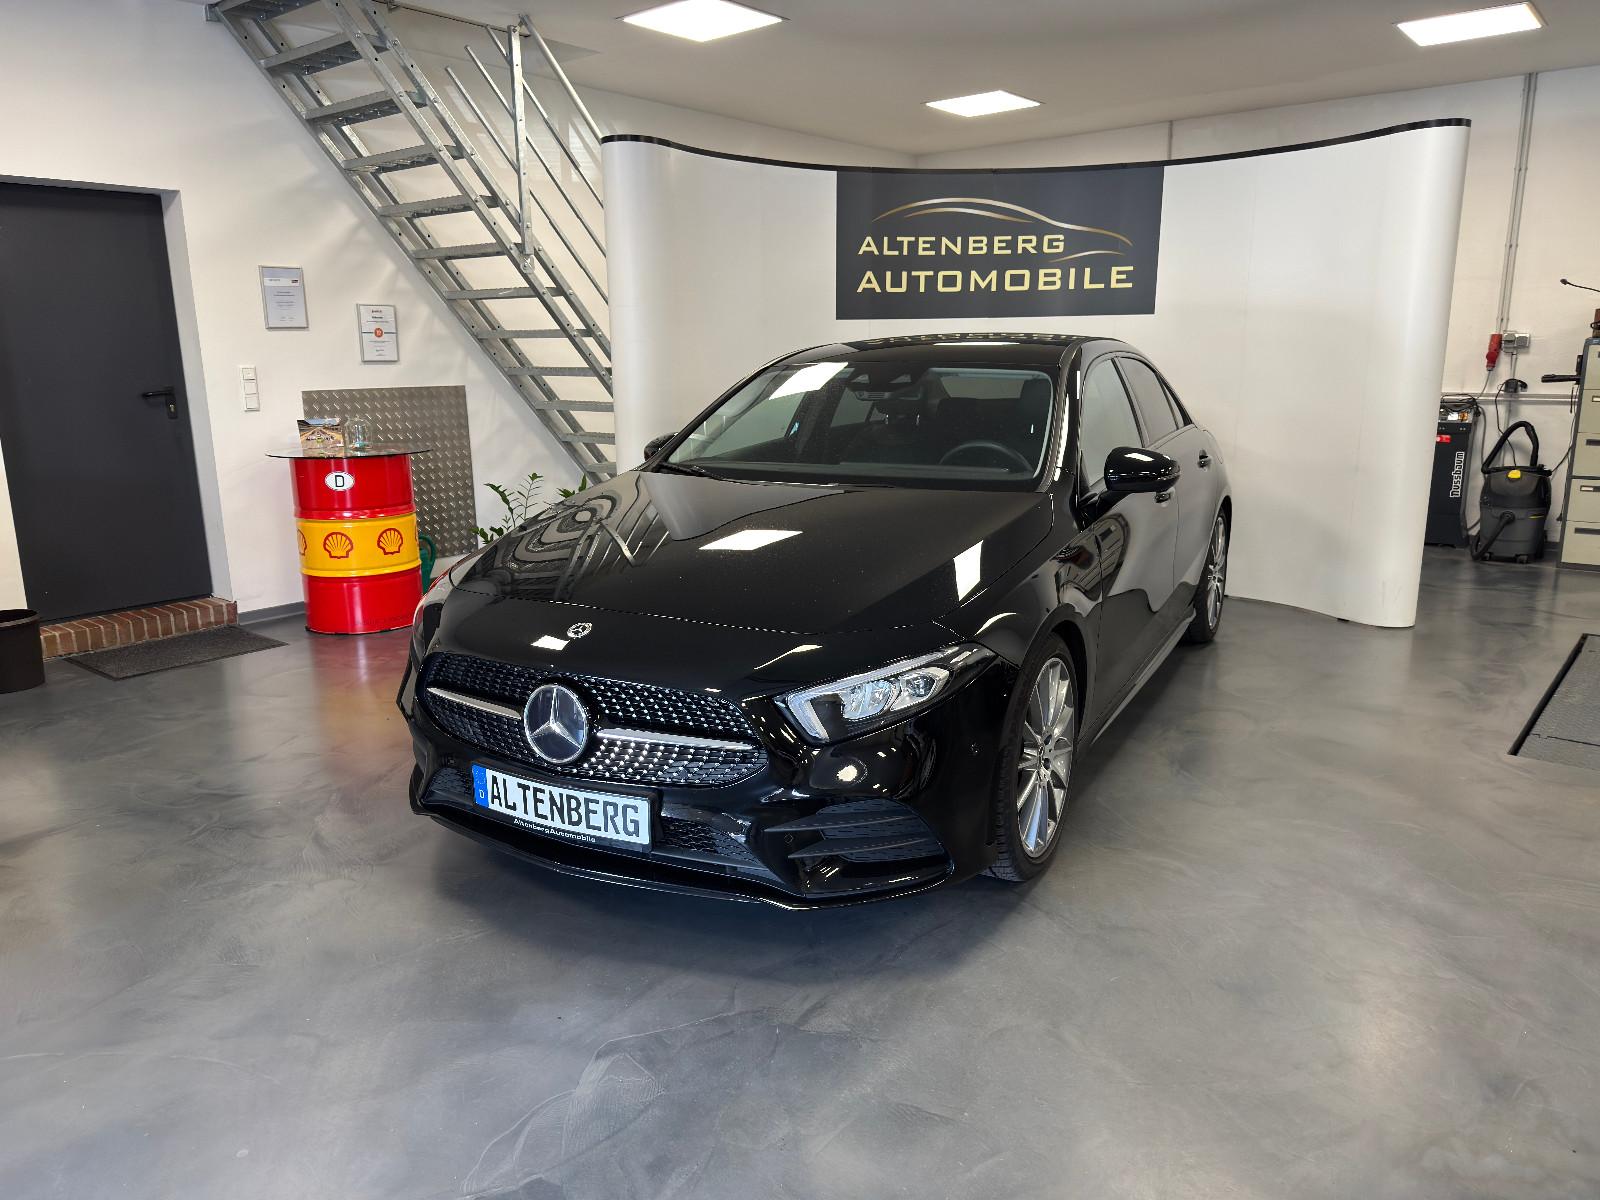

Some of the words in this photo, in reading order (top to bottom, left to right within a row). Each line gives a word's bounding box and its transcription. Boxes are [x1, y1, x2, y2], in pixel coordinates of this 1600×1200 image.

[857, 234, 1066, 257] ALTENBERG
[856, 265, 1135, 294] AUTOMOBILE
[334, 474, 345, 488] D
[491, 774, 641, 838] ALTENBERG
